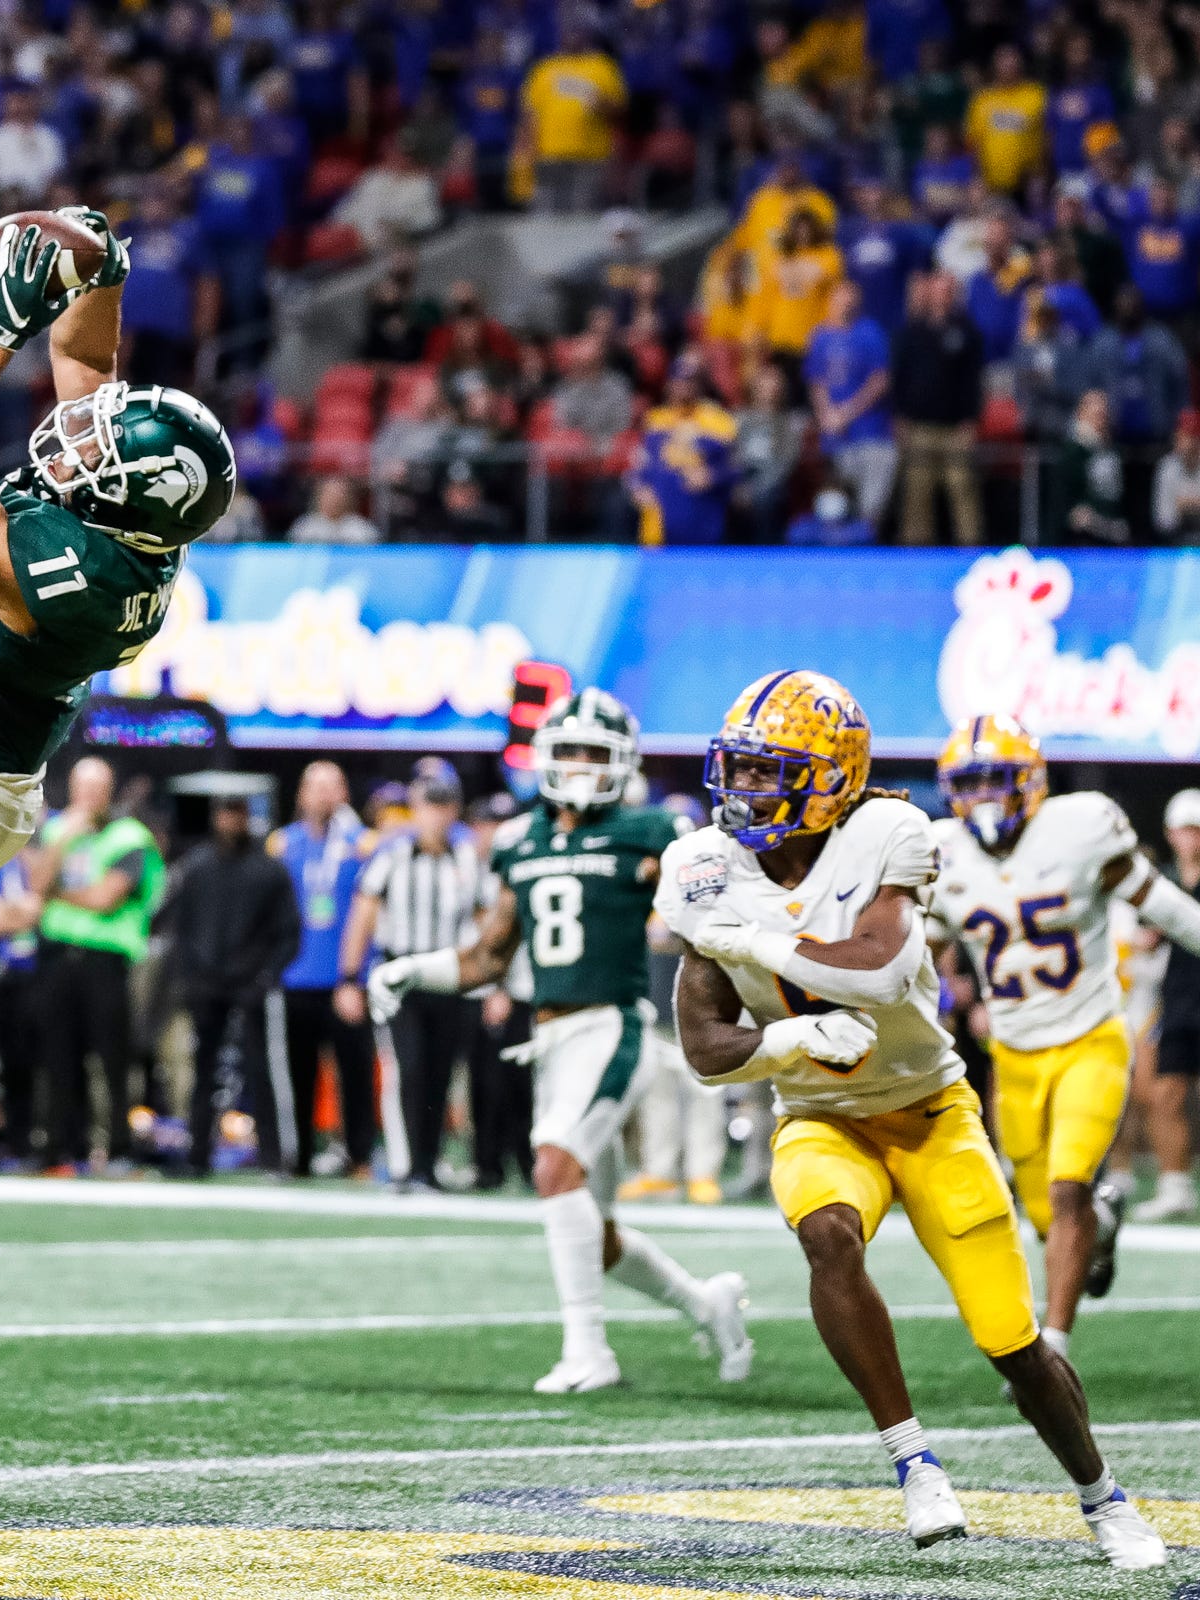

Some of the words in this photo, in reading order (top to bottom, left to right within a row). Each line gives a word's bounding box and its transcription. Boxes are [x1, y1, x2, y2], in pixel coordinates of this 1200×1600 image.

[28, 546, 88, 600] 11
[529, 874, 585, 968] 8
[963, 893, 1084, 1002] 25
